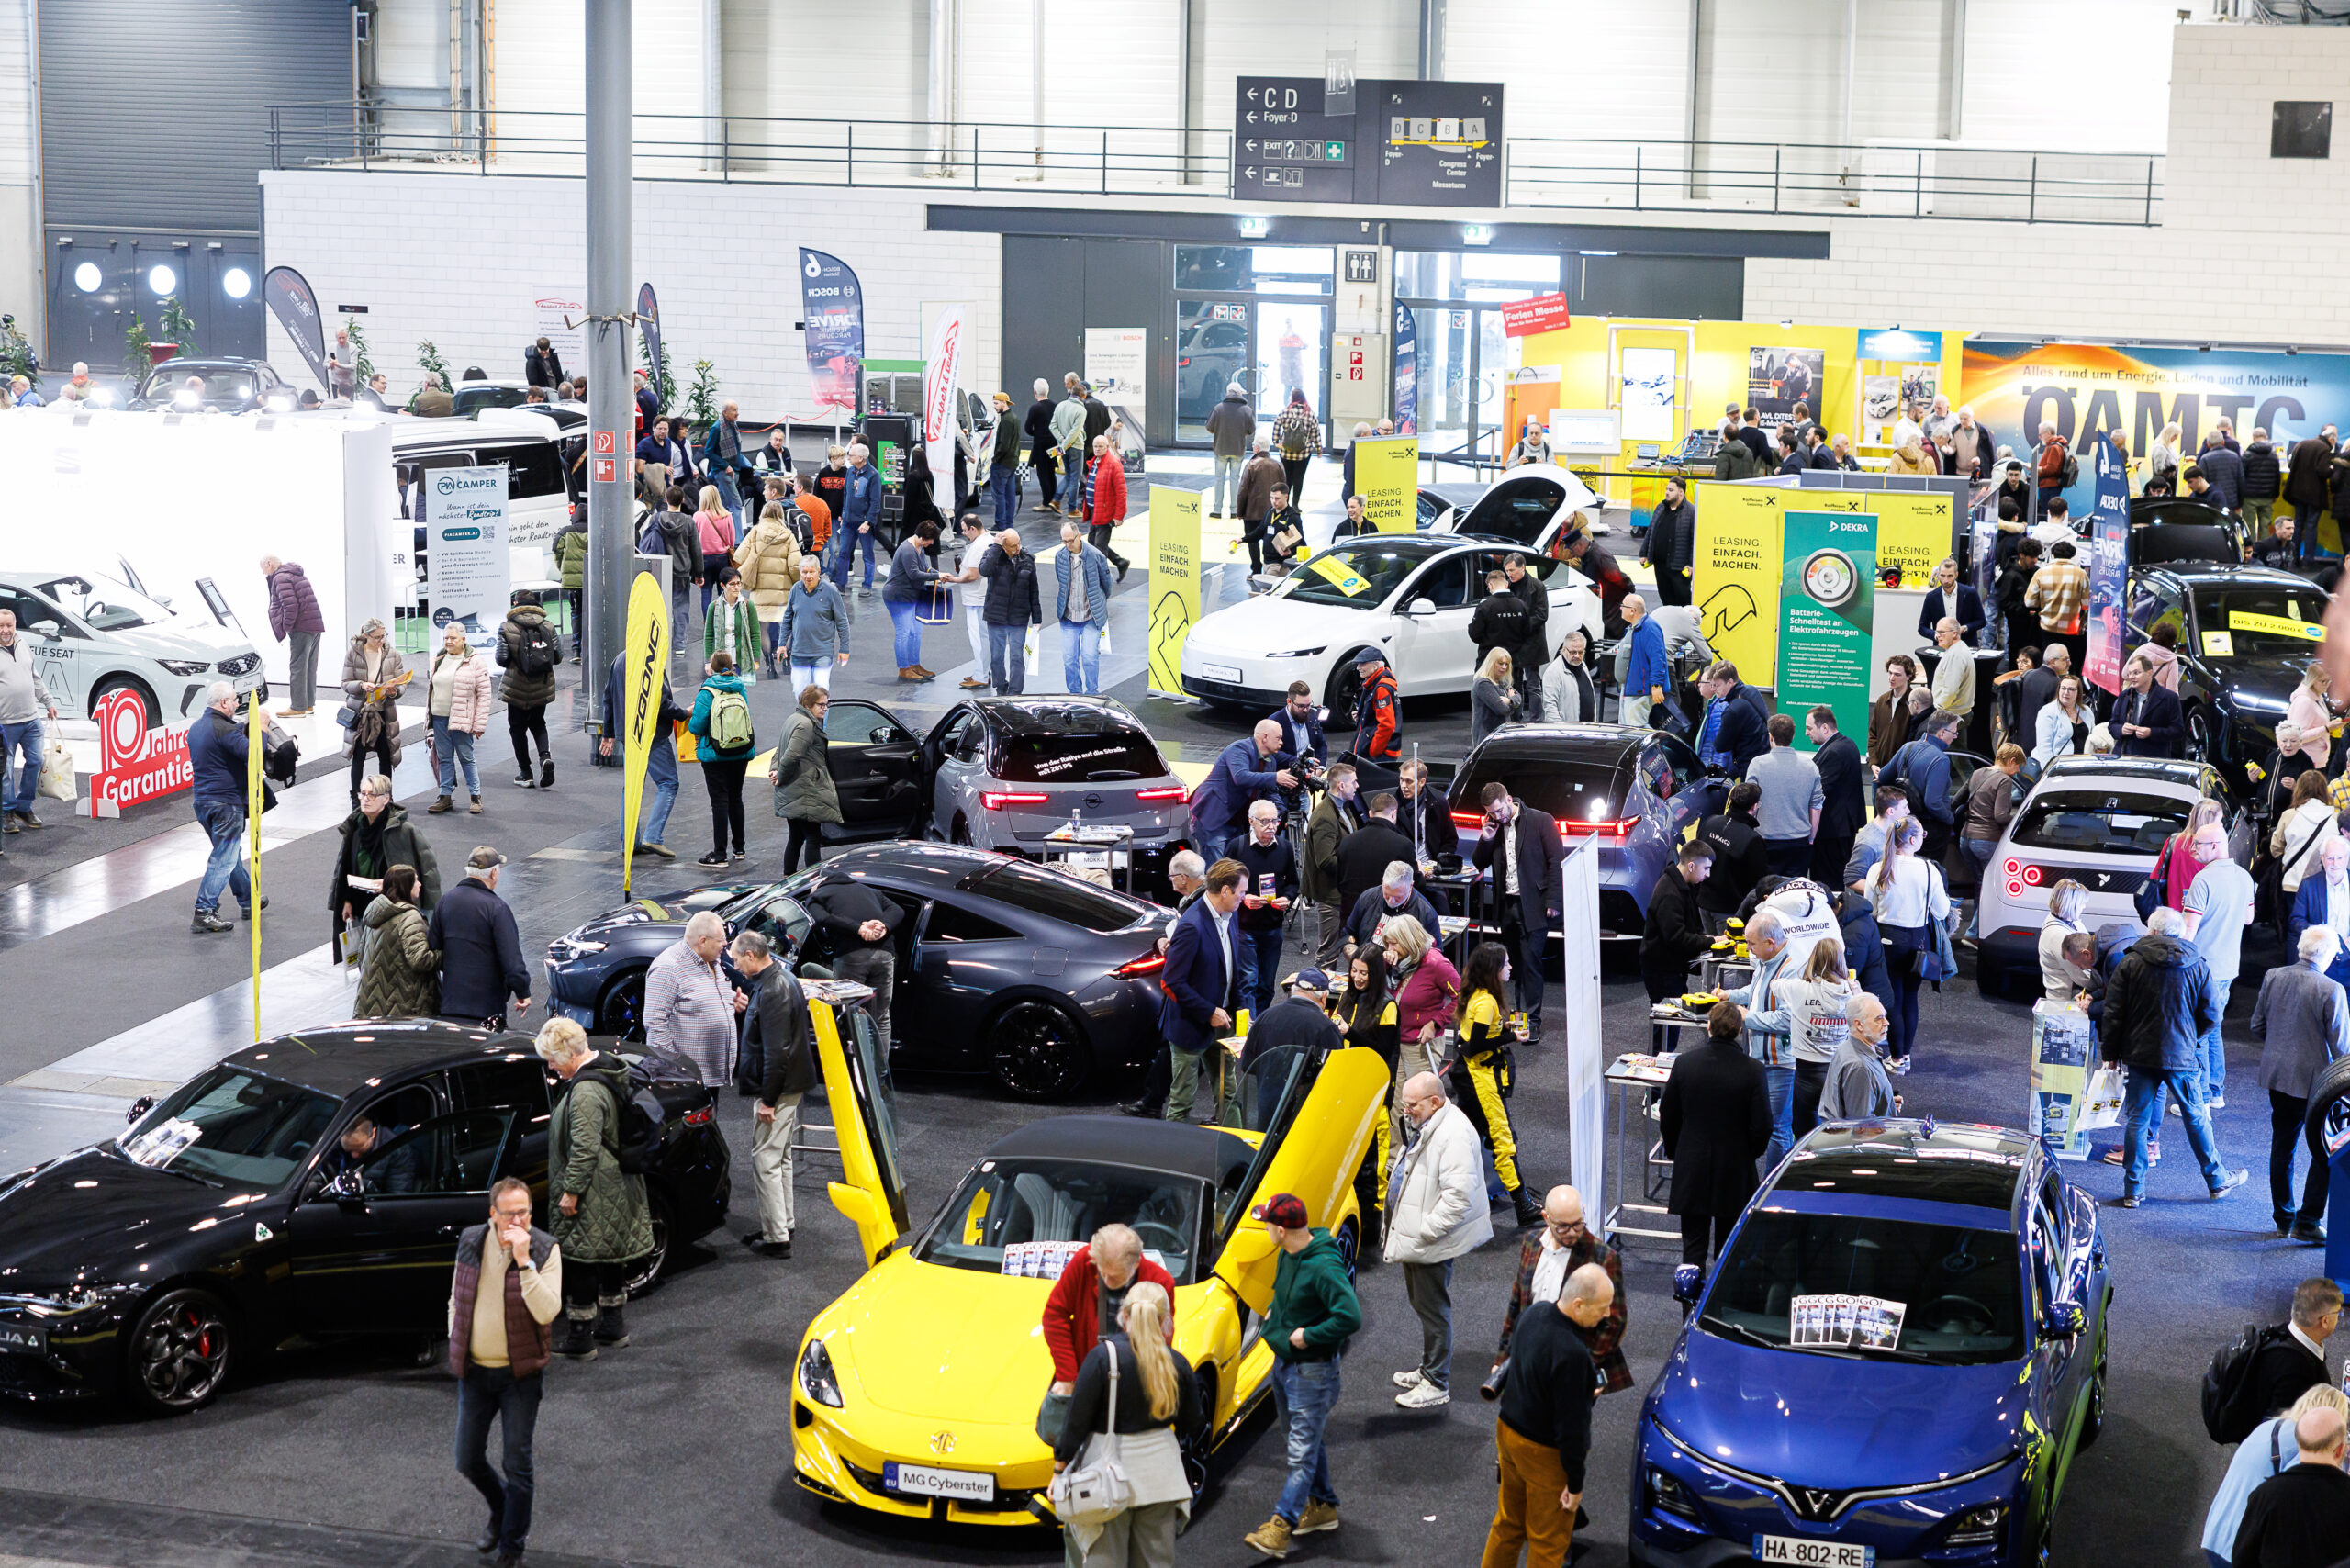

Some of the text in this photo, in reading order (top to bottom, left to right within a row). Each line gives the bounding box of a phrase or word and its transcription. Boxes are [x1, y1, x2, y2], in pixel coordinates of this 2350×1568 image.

[1264, 87, 1298, 109] C D
[1264, 111, 1298, 124] Foyer-D
[1395, 123, 1478, 135] D C B A
[1264, 142, 1282, 151] EXIT
[1385, 150, 1404, 159] Foyer-
[1475, 152, 1495, 162] Foyer-
[1384, 158, 1391, 166] D
[1438, 160, 1467, 169] Congress
[1475, 161, 1482, 169] A
[1505, 304, 1565, 322] Ferien Messe
[2022, 365, 2054, 377] Alles
[2059, 368, 2088, 379] rund
[2092, 372, 2112, 380] um
[2175, 372, 2214, 384] Laden
[2219, 375, 2244, 386] und
[2248, 375, 2309, 388] Mobilität
[2022, 386, 2306, 459] ÖAMTC
[456, 478, 497, 489] CAMPER
[1367, 487, 1404, 498] LEASING.
[1367, 498, 1404, 509] EINFACH.
[438, 512, 467, 521] nächster
[1366, 510, 1404, 519] MACHEN.
[519, 520, 550, 533] geht dein
[1841, 522, 1869, 532] DEKRA
[509, 533, 527, 543] hster
[1713, 536, 1762, 547] LEASING.
[1159, 542, 1190, 555] LEASING.
[1713, 548, 1762, 559] EINFACH.
[1882, 545, 1933, 556] LEASING.
[1159, 554, 1191, 567] EINFACH.
[1712, 560, 1762, 571] MACHEN.
[1882, 557, 1933, 568] EINFACH.
[1159, 566, 1191, 578] MACHEN.
[1790, 608, 1824, 617] Batterie-
[1789, 617, 1831, 626] Schnelltest
[1789, 625, 1859, 637] Elektrofahrzeugen
[2270, 623, 2296, 633] 2.000
[532, 641, 548, 649] FILA
[50, 648, 75, 659] SEAT
[633, 620, 660, 744] ZGONC
[91, 689, 147, 773] 10
[1034, 762, 1048, 770] Von
[1059, 755, 1081, 764] Rallye
[1037, 768, 1051, 777] mit
[1050, 765, 1063, 773] 281
[103, 755, 194, 804] Garantie
[1774, 881, 1804, 897] BLACK
[1783, 922, 1830, 935] WORLDWIDE
[2091, 1099, 2122, 1113] ZONC
[1860, 1296, 1883, 1308] GO!
[885, 1478, 897, 1487] EU
[904, 1473, 990, 1494] MG Cyberster
[1765, 1539, 1862, 1567] HA-802-RE
[1864, 1560, 1876, 1568] 57
